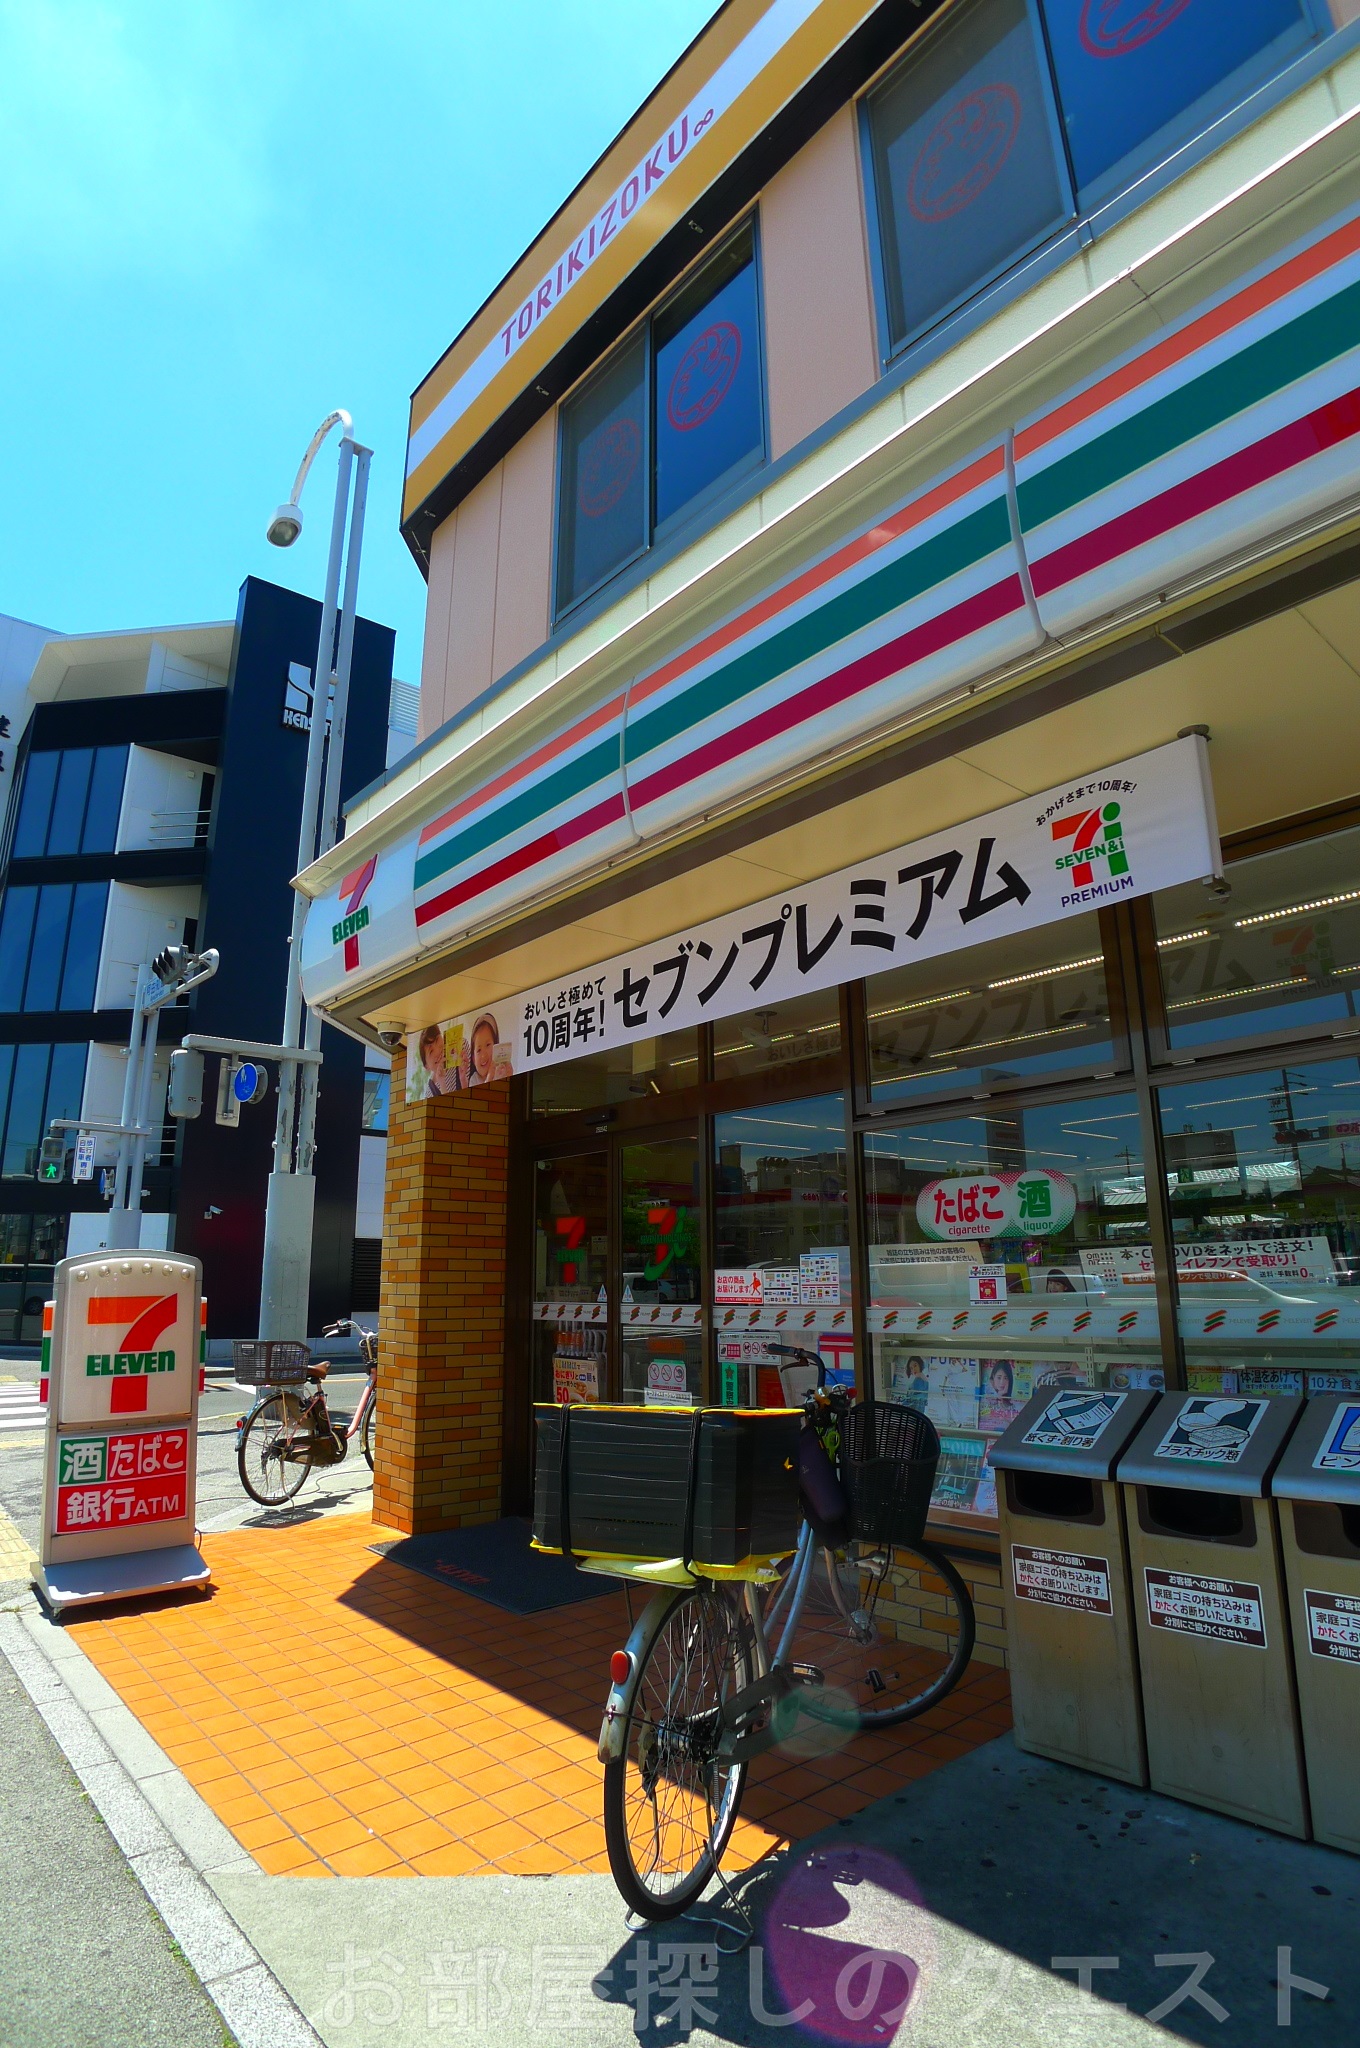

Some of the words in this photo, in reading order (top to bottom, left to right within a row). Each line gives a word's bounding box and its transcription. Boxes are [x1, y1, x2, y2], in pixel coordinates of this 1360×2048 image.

[501, 115, 689, 357] TORIKIZOKU
[1061, 876, 1134, 908] PREMIUM
[613, 837, 1032, 1028] セブンプレミアム
[524, 976, 607, 1020] おいしさ極めて
[523, 999, 605, 1057] 10周年!
[934, 1184, 1004, 1224] たばこ
[1017, 1179, 1052, 1218] 酒
[948, 1224, 991, 1236] cigarette
[1023, 1219, 1054, 1232] liquor
[1240, 1370, 1302, 1384] 体温をあげて
[557, 1386, 569, 1403] 50
[62, 1442, 105, 1483] 酒
[109, 1434, 184, 1478] たばこ
[1157, 1444, 1240, 1462] プラスチック類
[1031, 1550, 1086, 1566] お客様へのお願い
[1019, 1562, 1102, 1584] 家庭ゴミの持ち込みは
[1020, 1573, 1105, 1597] かたくお断りいたします。
[1168, 1575, 1234, 1593] お客様へのお願い
[1153, 1587, 1253, 1614] 家庭ゴミの持ち込みは
[1155, 1600, 1257, 1628] かたくお断りいたします。
[1164, 1616, 1248, 1641] 分別にご協力ください。
